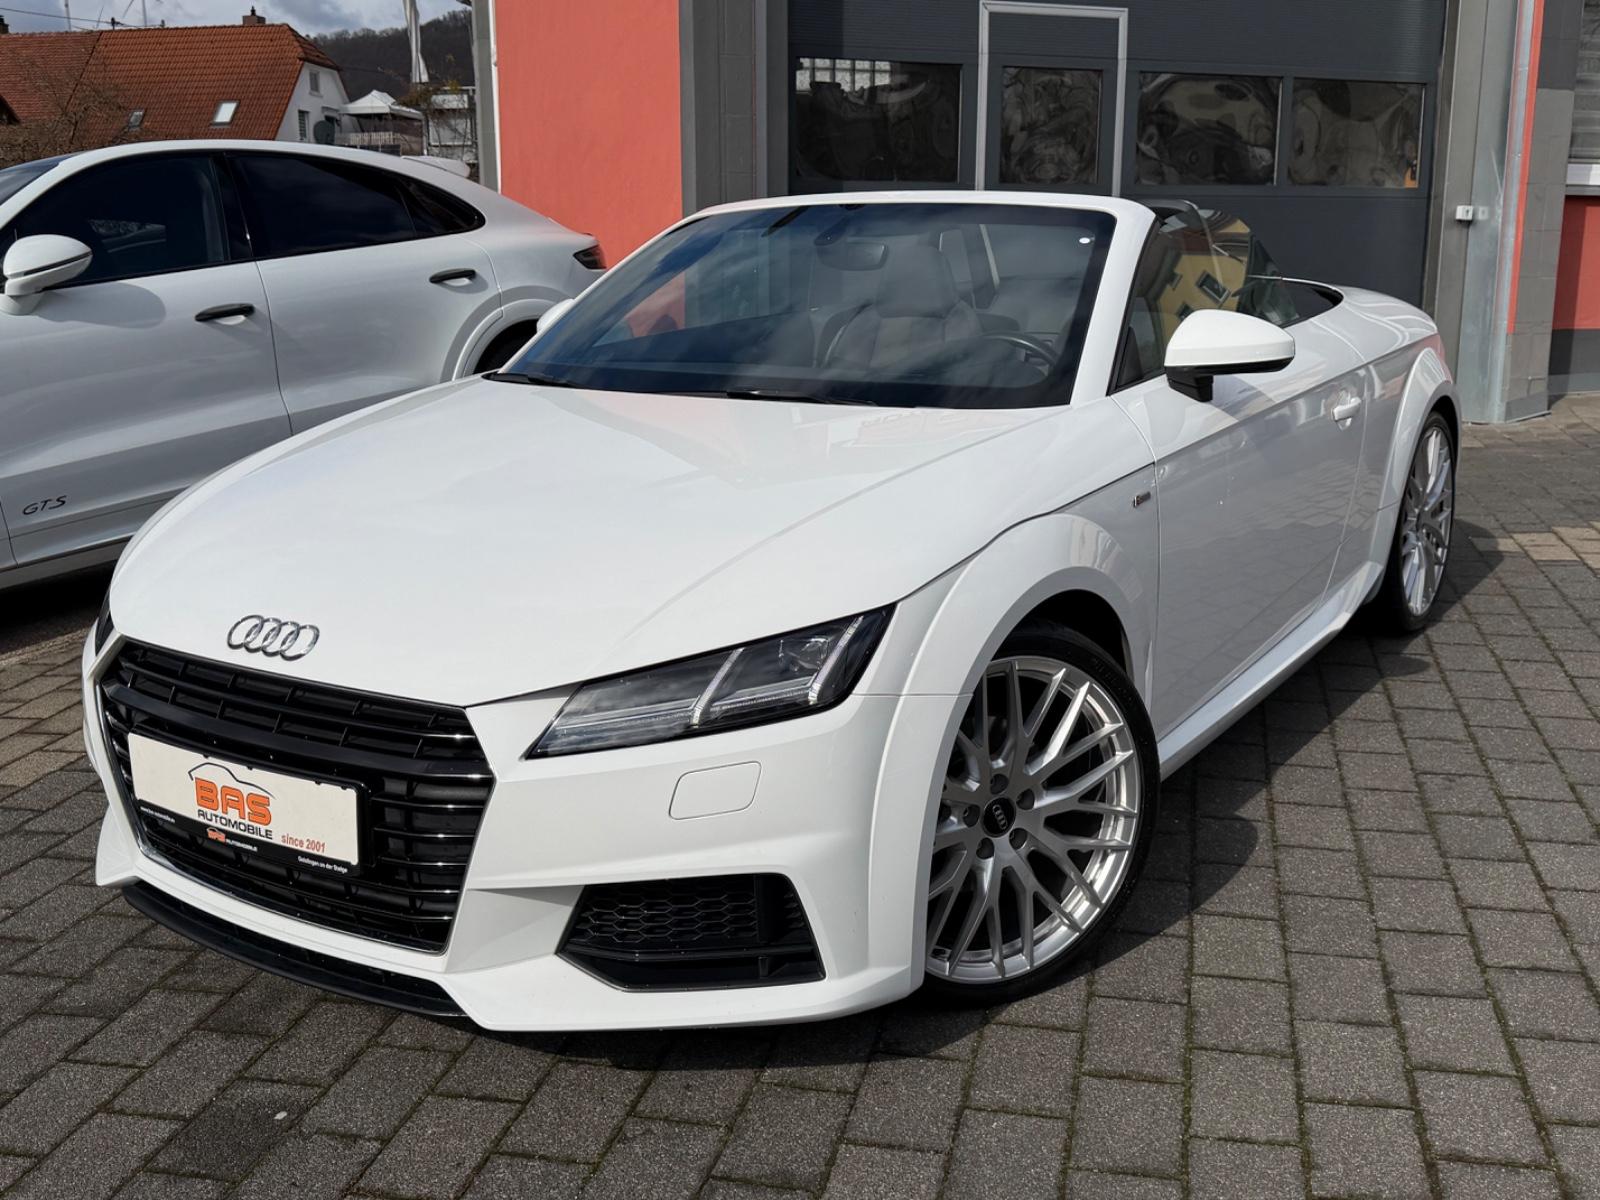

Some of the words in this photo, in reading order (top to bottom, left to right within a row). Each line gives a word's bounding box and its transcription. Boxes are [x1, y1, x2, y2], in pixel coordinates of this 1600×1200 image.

[22, 495, 67, 515] GTS
[195, 777, 271, 826] BAS
[198, 809, 273, 839] AUTOMOBILE
[281, 833, 304, 848] since
[306, 838, 326, 853] 2001
